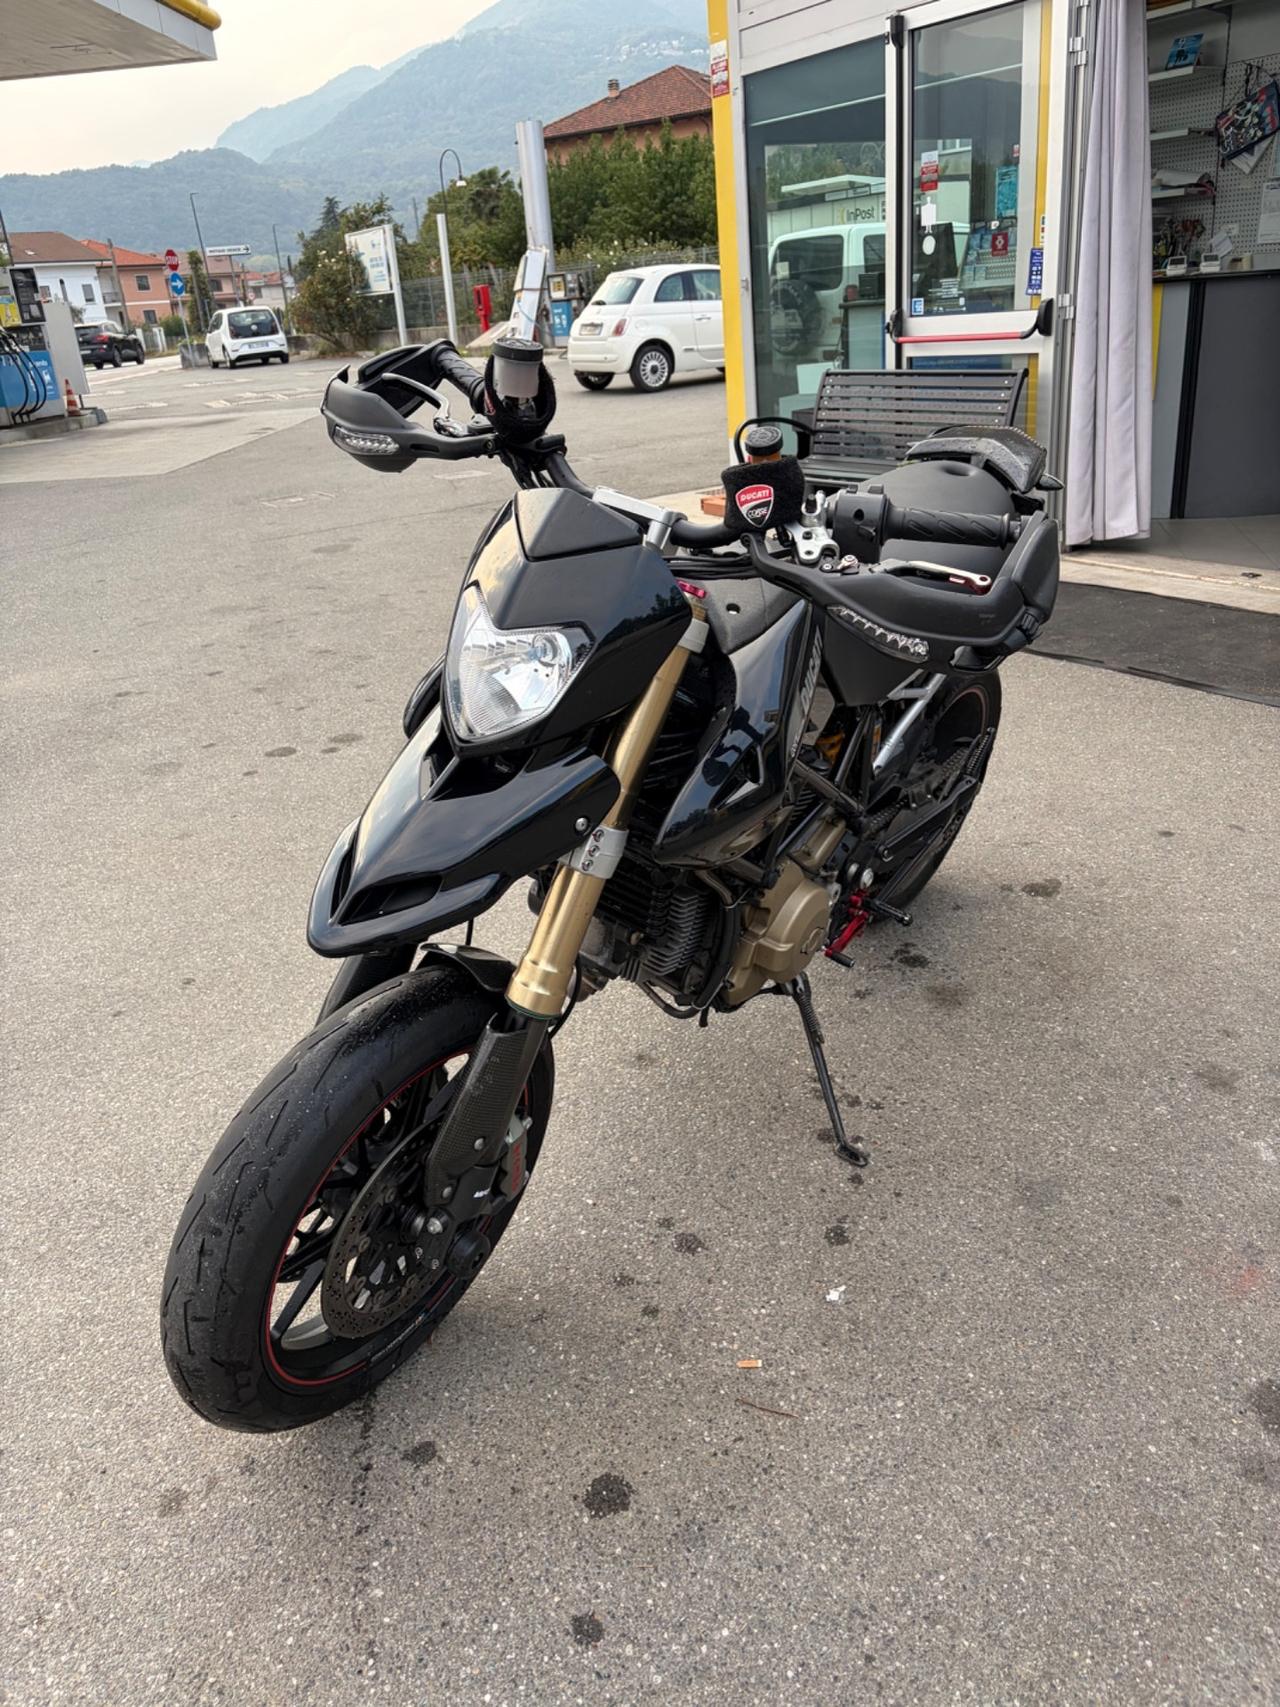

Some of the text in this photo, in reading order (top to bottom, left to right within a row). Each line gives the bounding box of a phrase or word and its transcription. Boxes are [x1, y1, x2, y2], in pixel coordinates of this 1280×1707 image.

[846, 207, 875, 221] InPost
[740, 490, 770, 502] DUCATI
[747, 506, 768, 519] CORSE
